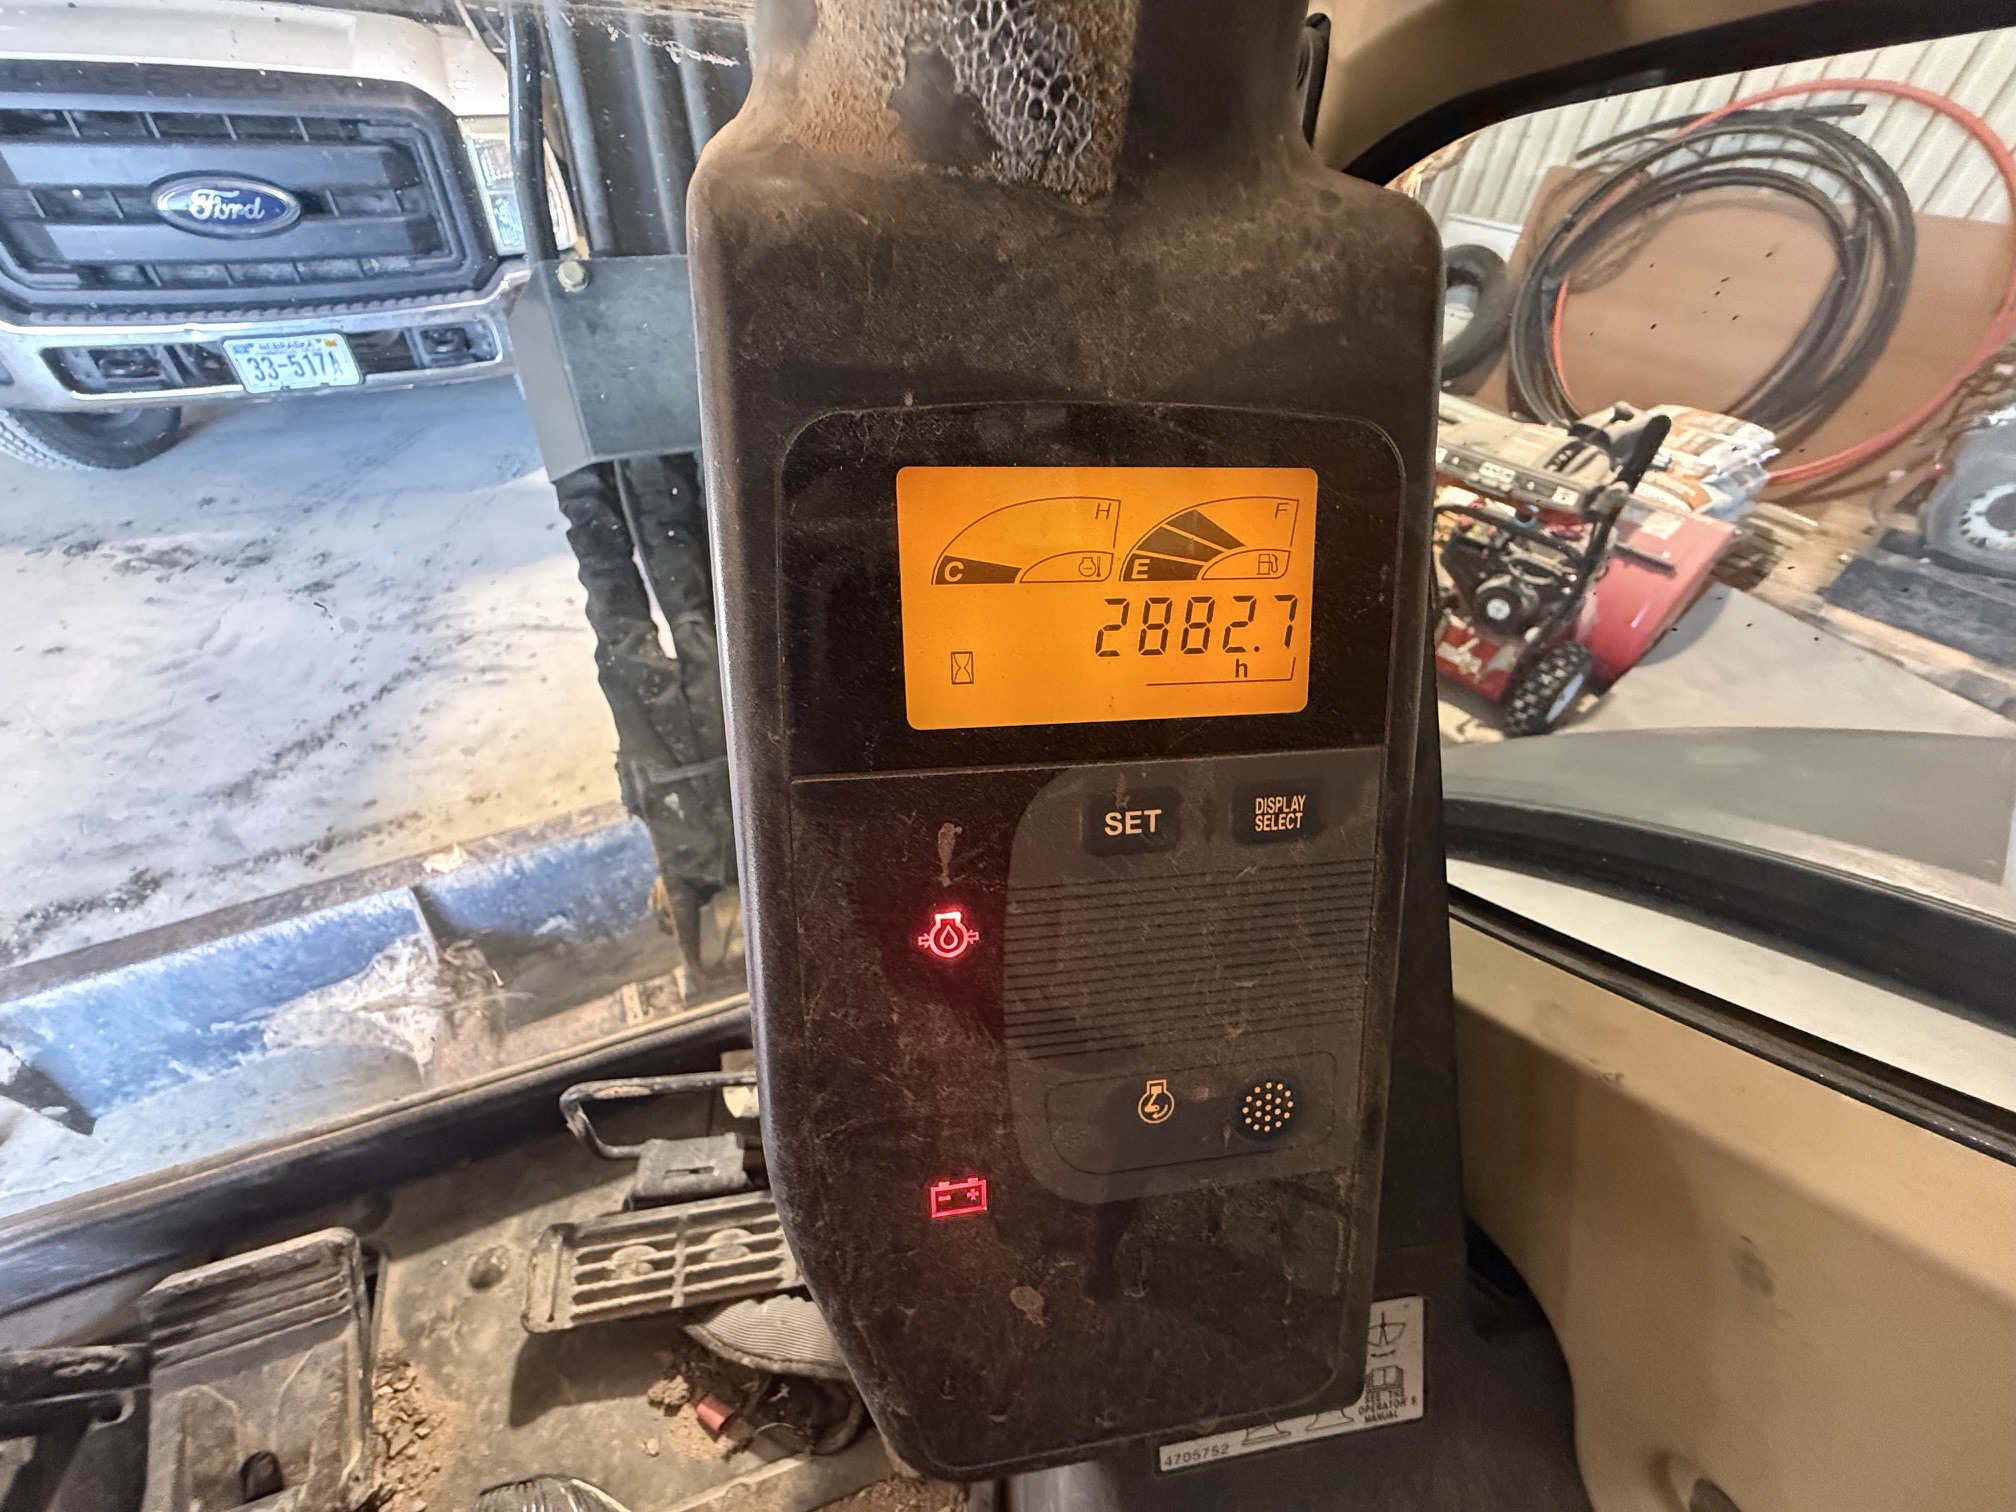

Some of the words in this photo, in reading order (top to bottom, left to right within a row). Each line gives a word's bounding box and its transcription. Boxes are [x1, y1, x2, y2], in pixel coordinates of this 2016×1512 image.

[188, 188, 266, 221] Ford
[246, 350, 344, 382] 33-517A
[1094, 502, 1112, 520] H
[1274, 502, 1290, 519] F
[944, 561, 964, 582] C
[1131, 558, 1151, 580] E
[1095, 595, 1298, 658] 2882.7
[1235, 659, 1248, 678] h
[1255, 795, 1306, 815] DISPLAY
[1104, 809, 1162, 836] SET
[1255, 812, 1303, 832] SELECT
[1358, 1395, 1417, 1415] OPERATORS
